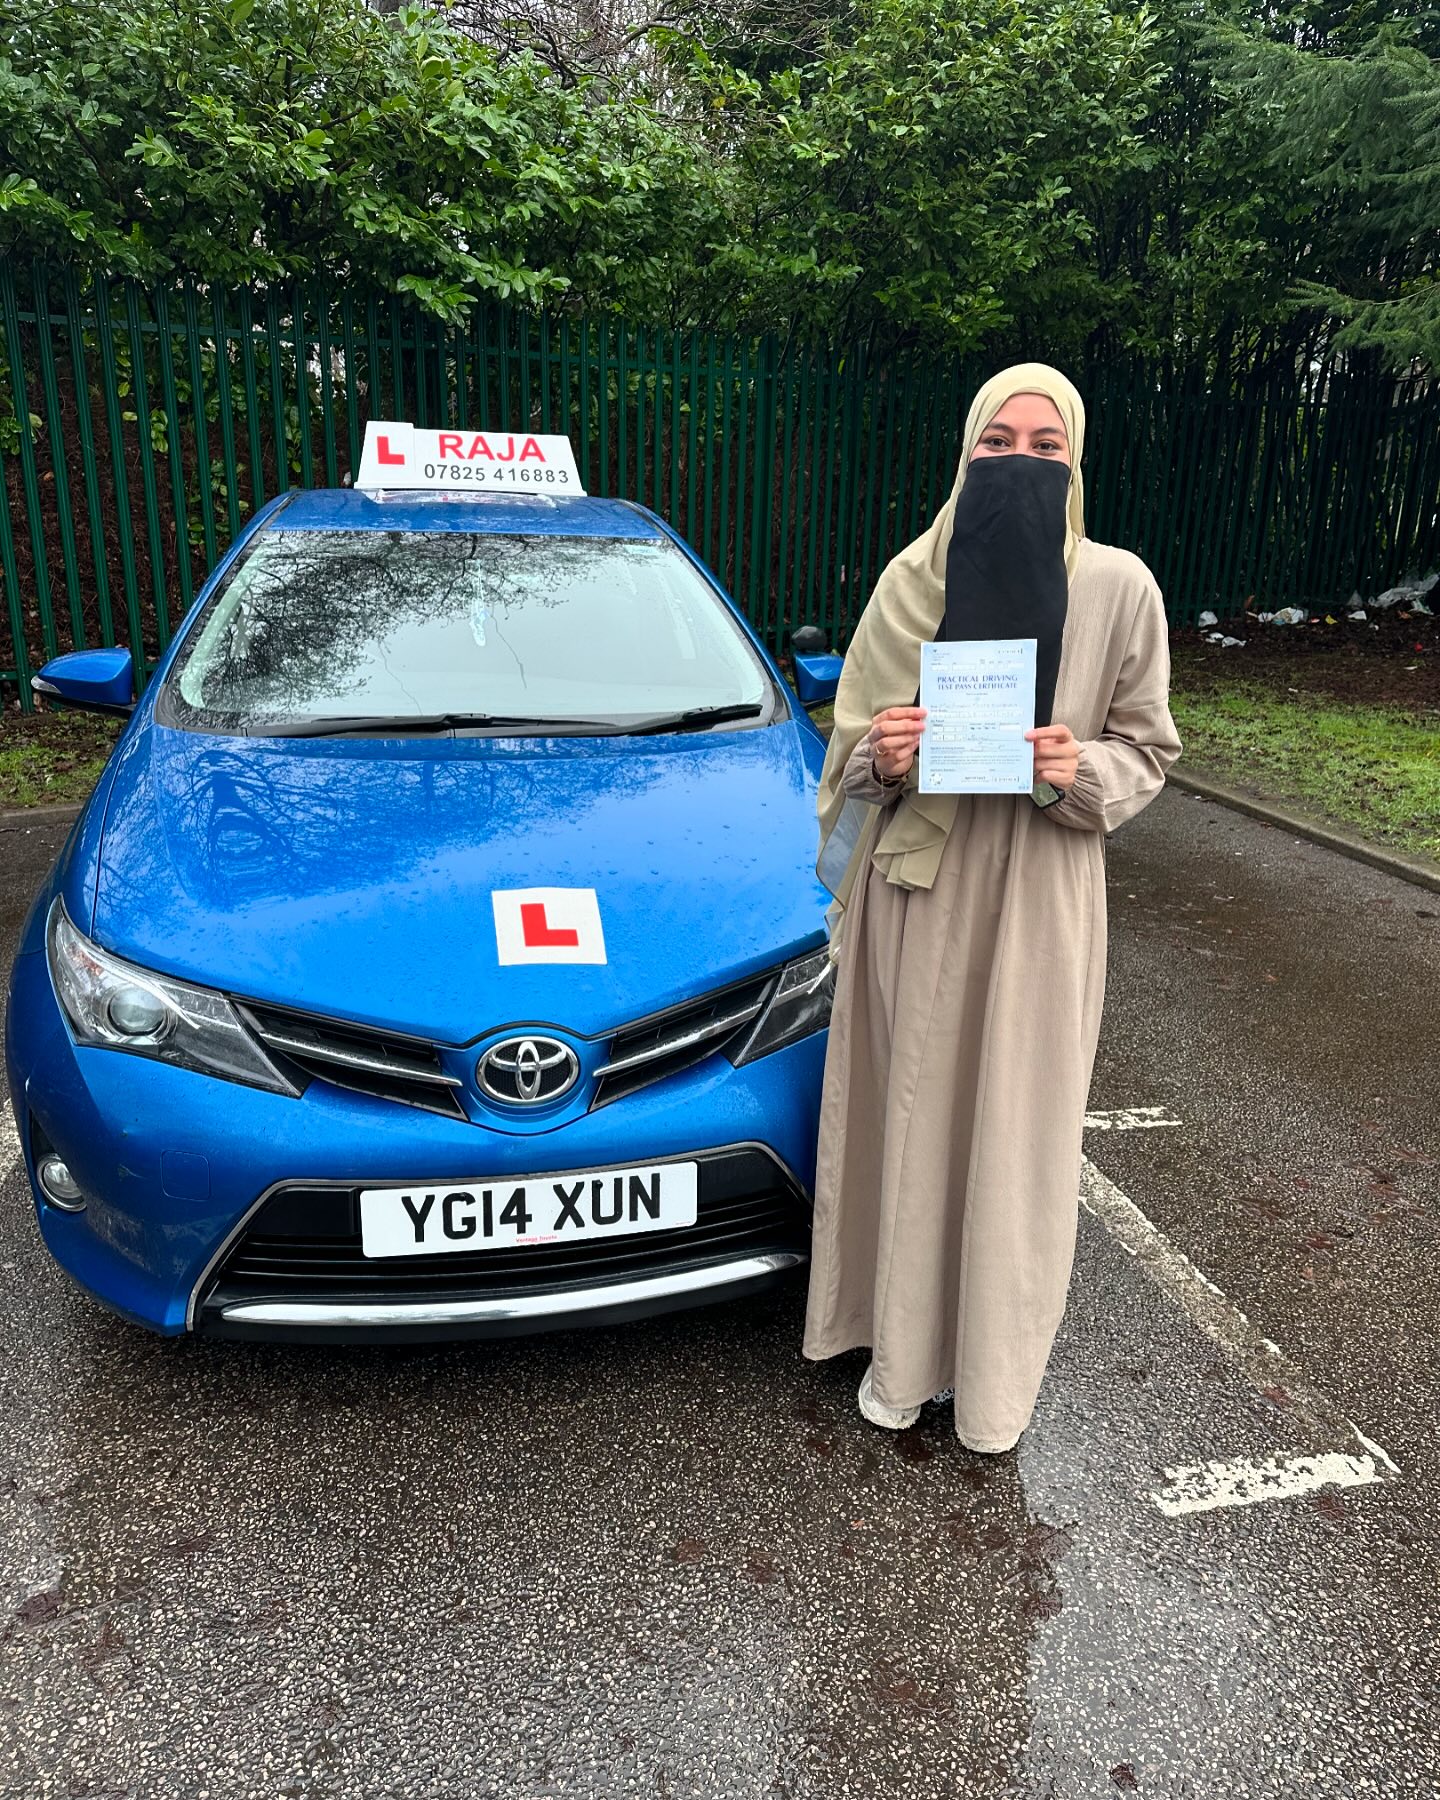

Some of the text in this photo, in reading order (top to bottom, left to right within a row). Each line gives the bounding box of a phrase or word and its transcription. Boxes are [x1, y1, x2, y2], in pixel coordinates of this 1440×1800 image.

[377, 436, 405, 465] L
[438, 434, 546, 462] RAJA
[424, 464, 569, 483] 07825 416883
[937, 674, 1018, 683] PRACTICAL DRIVING
[973, 682, 1018, 690] CERTIFICATE
[520, 903, 579, 947] L
[401, 1172, 660, 1243] YG14 XUN
